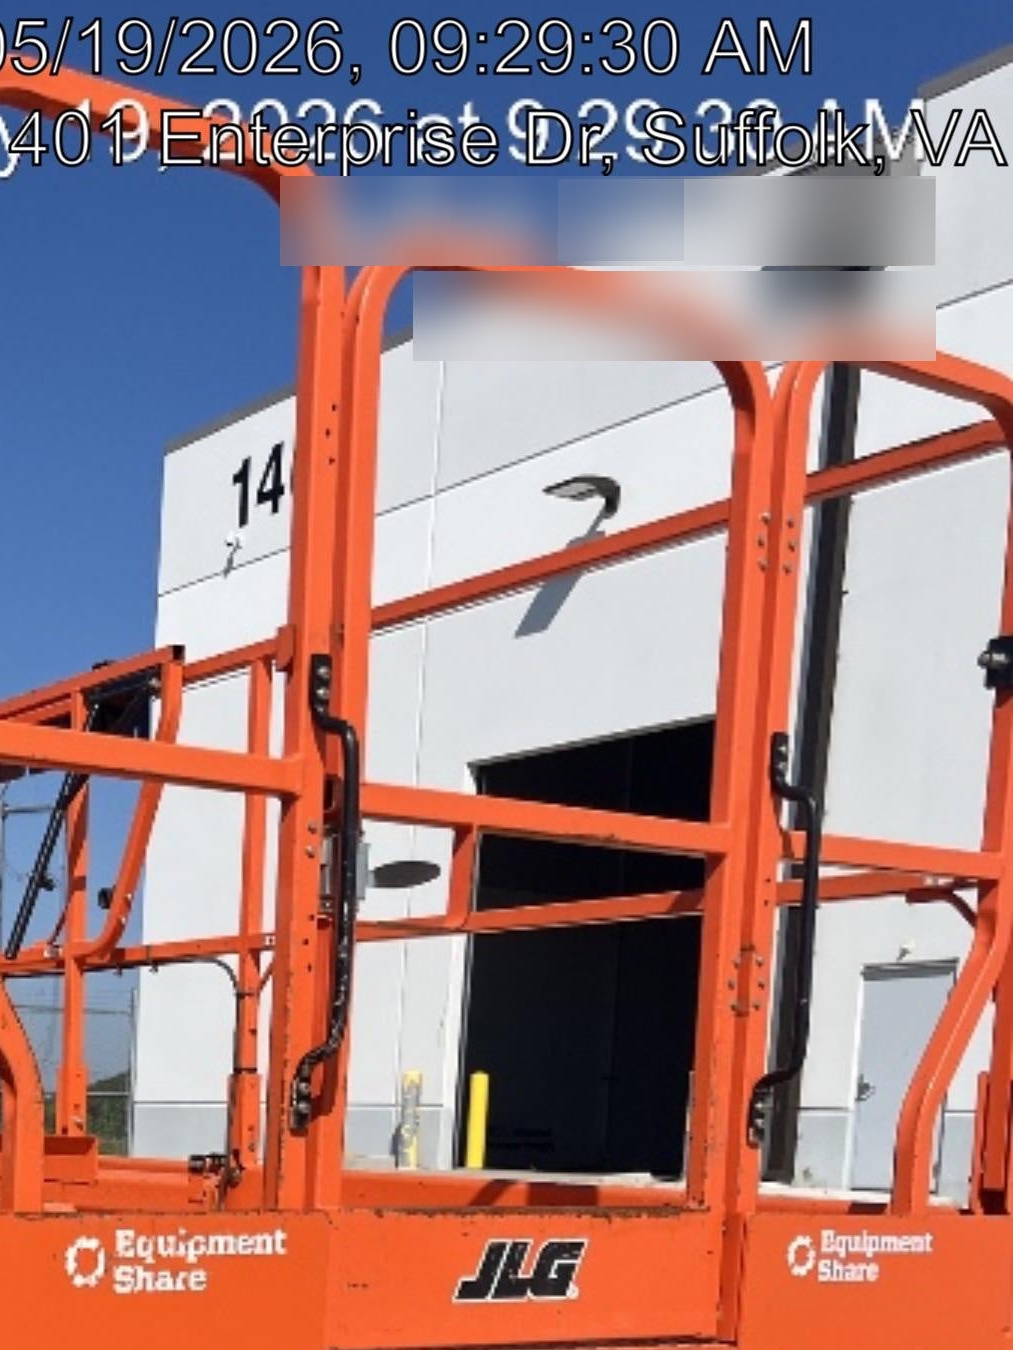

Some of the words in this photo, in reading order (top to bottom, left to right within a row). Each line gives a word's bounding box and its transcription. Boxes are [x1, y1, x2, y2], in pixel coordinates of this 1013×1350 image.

[232, 441, 294, 528] 14
[114, 1229, 286, 1262] Equipment
[820, 1229, 934, 1258] Equipment
[114, 1266, 207, 1294] Share
[452, 1238, 589, 1303] JLG
[817, 1259, 880, 1283] Share
